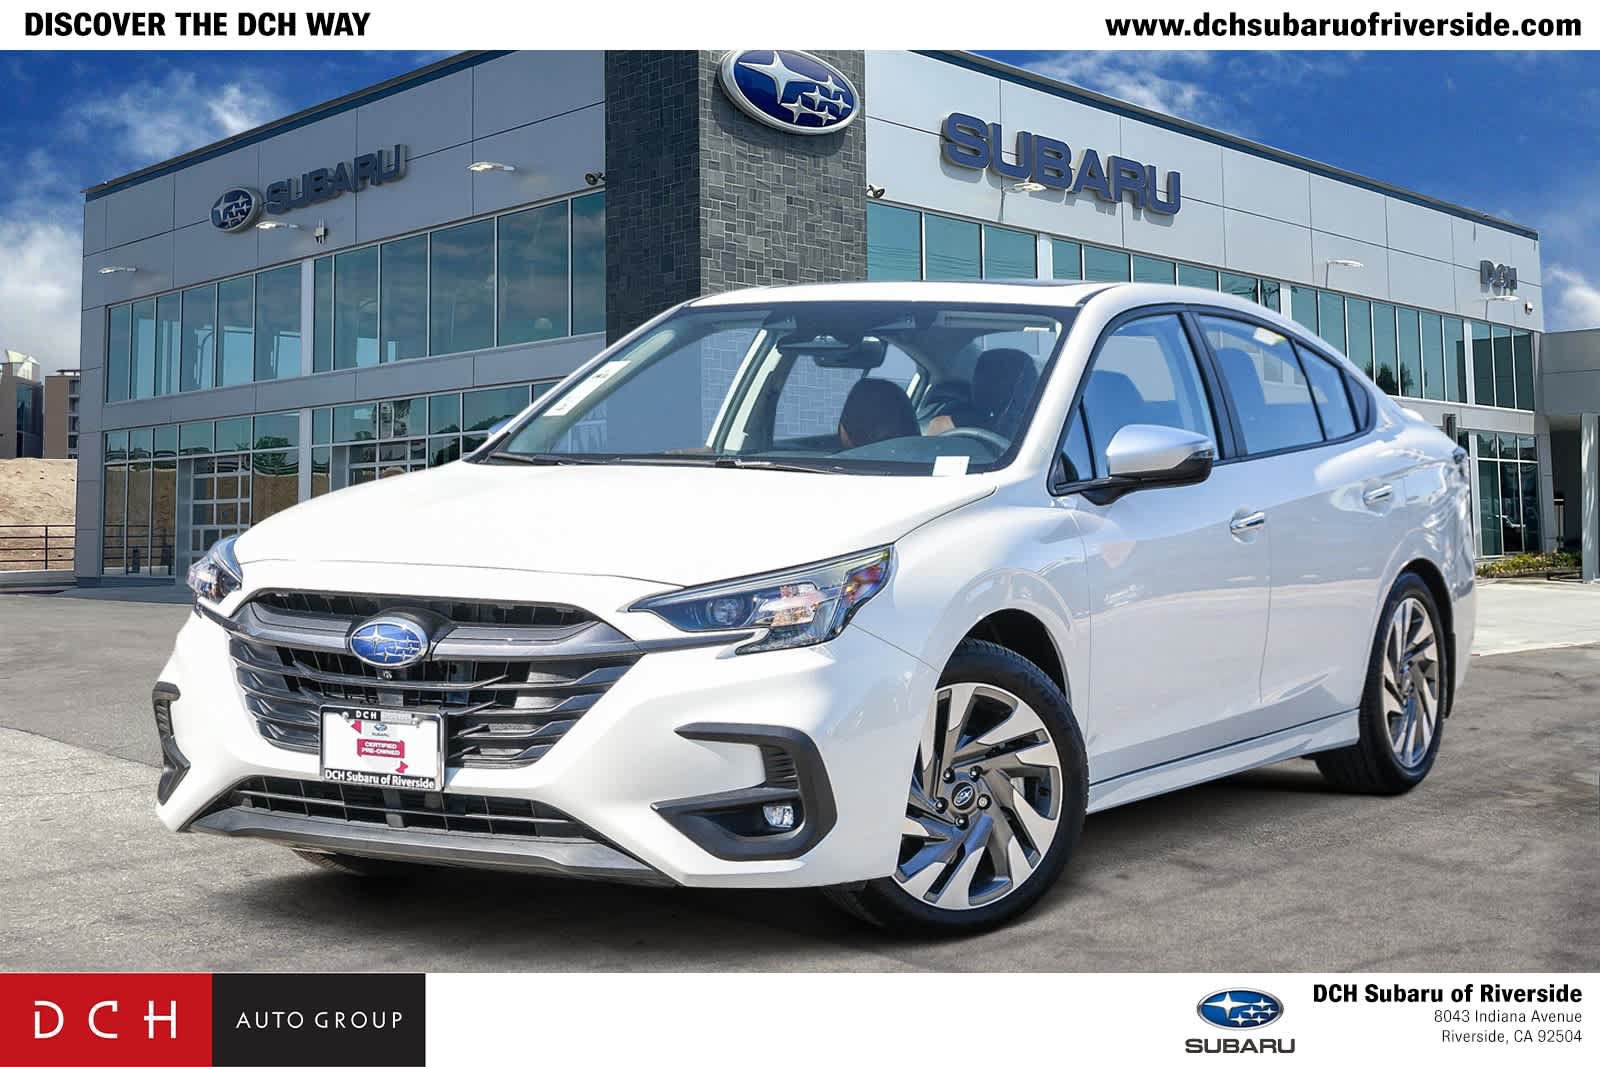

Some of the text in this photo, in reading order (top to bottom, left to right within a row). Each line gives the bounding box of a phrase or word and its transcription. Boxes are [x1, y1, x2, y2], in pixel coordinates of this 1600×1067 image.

[265, 143, 408, 215] SUBARU
[941, 112, 1181, 215] SUBARU
[355, 710, 377, 720] DCH
[325, 769, 435, 789] DCH Subaru of Riverside
